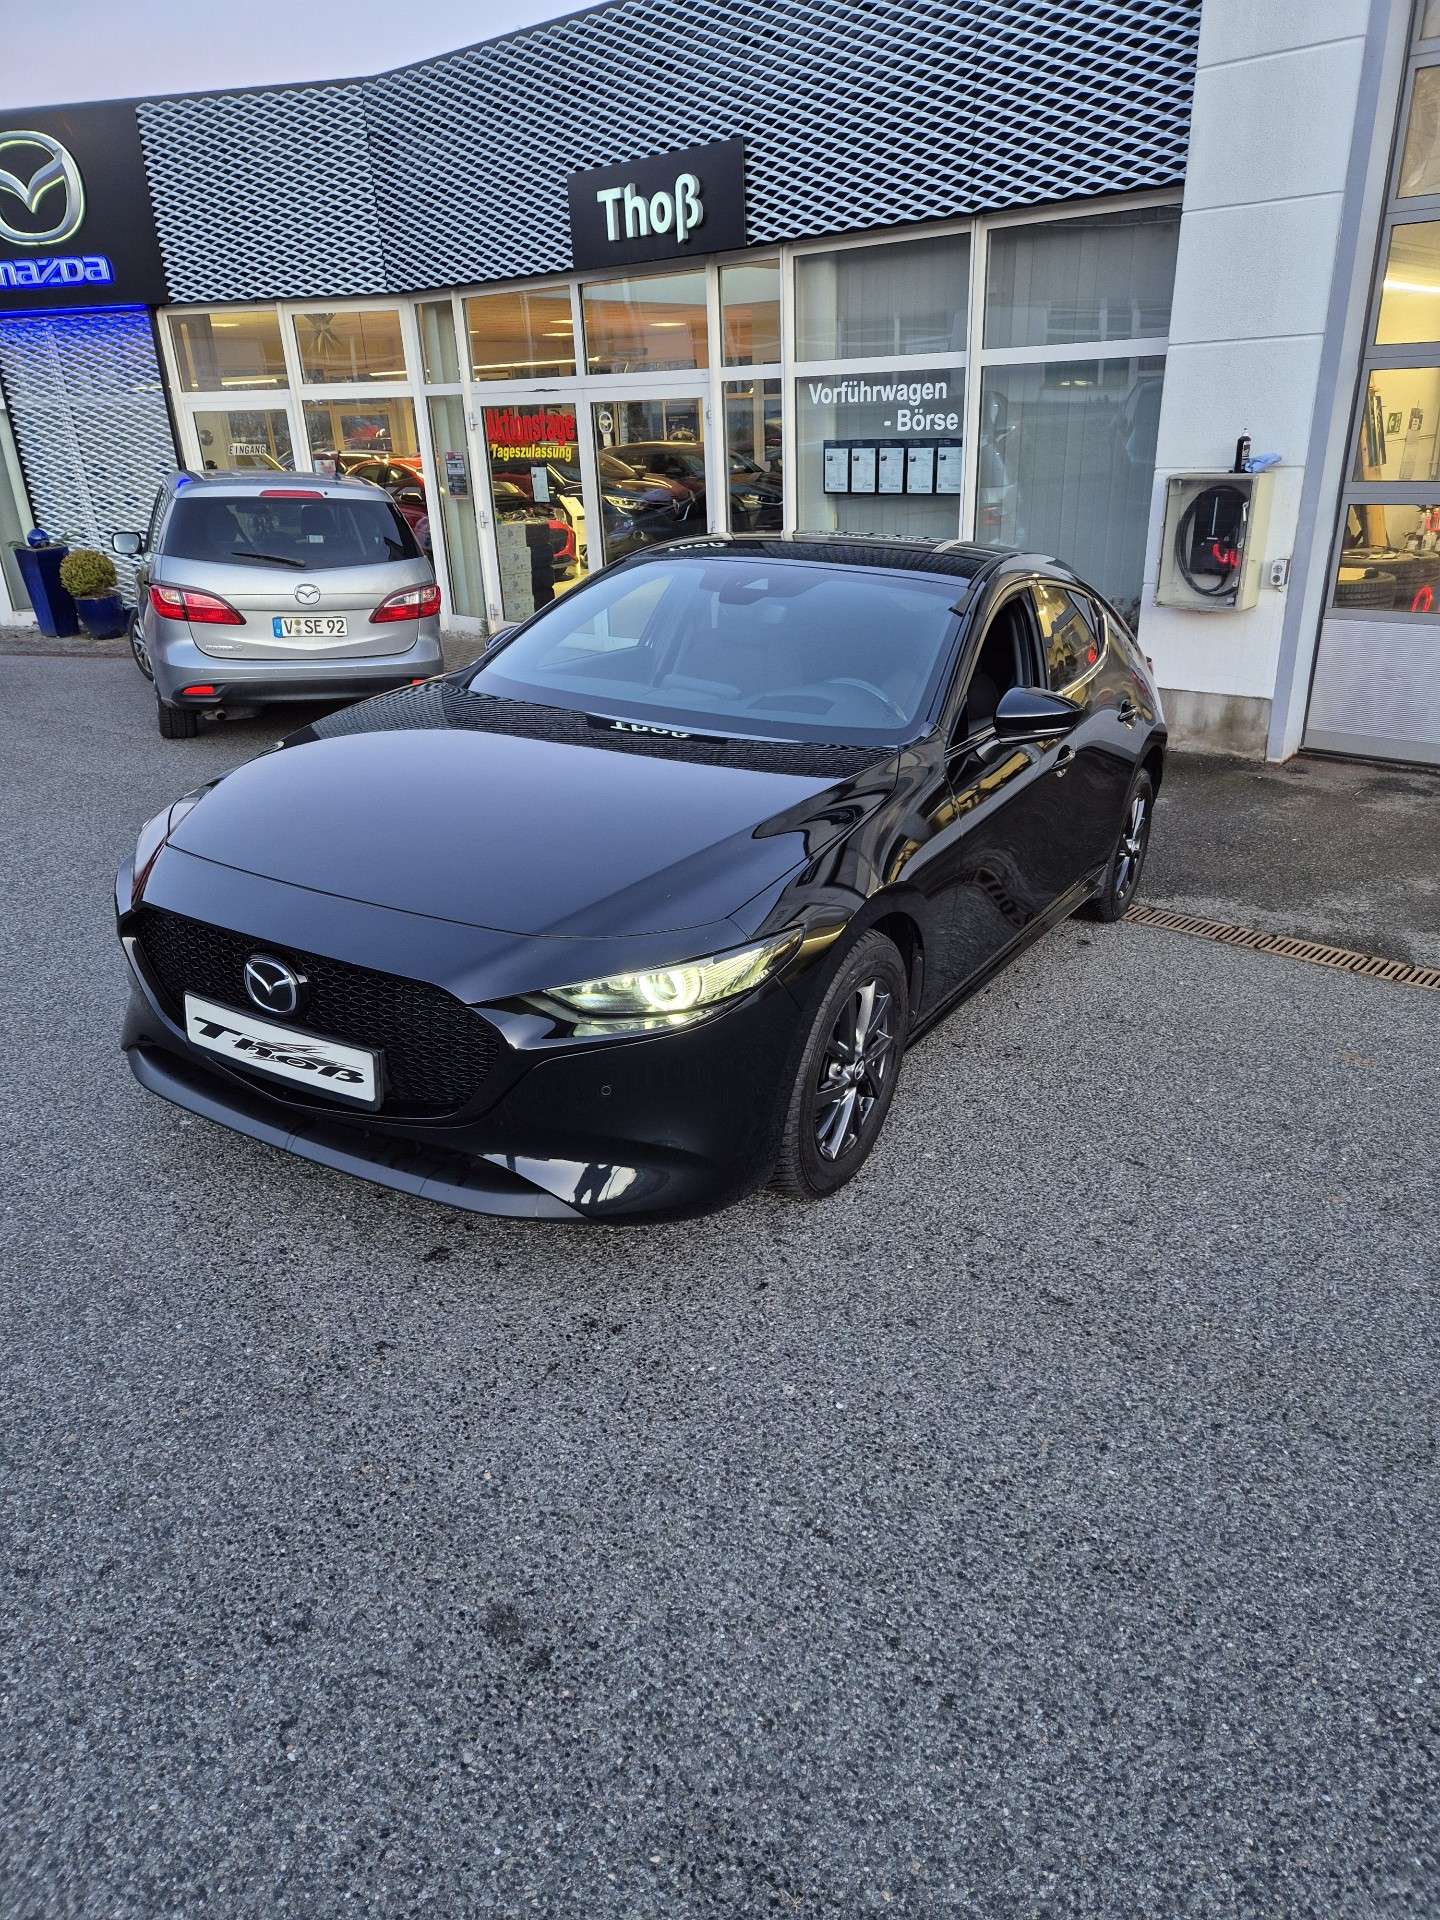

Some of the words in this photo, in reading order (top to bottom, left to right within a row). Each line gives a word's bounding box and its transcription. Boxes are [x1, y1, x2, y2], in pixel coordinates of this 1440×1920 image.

[597, 173, 704, 243] Thoß
[808, 381, 948, 406] Vorführwagen
[486, 408, 575, 446] Aktionstage
[897, 408, 959, 432] Börse
[229, 444, 266, 455] EINGANG
[490, 443, 572, 462] Tageszulassung
[283, 620, 293, 634] V
[304, 620, 323, 634] SE
[327, 620, 345, 634] 92
